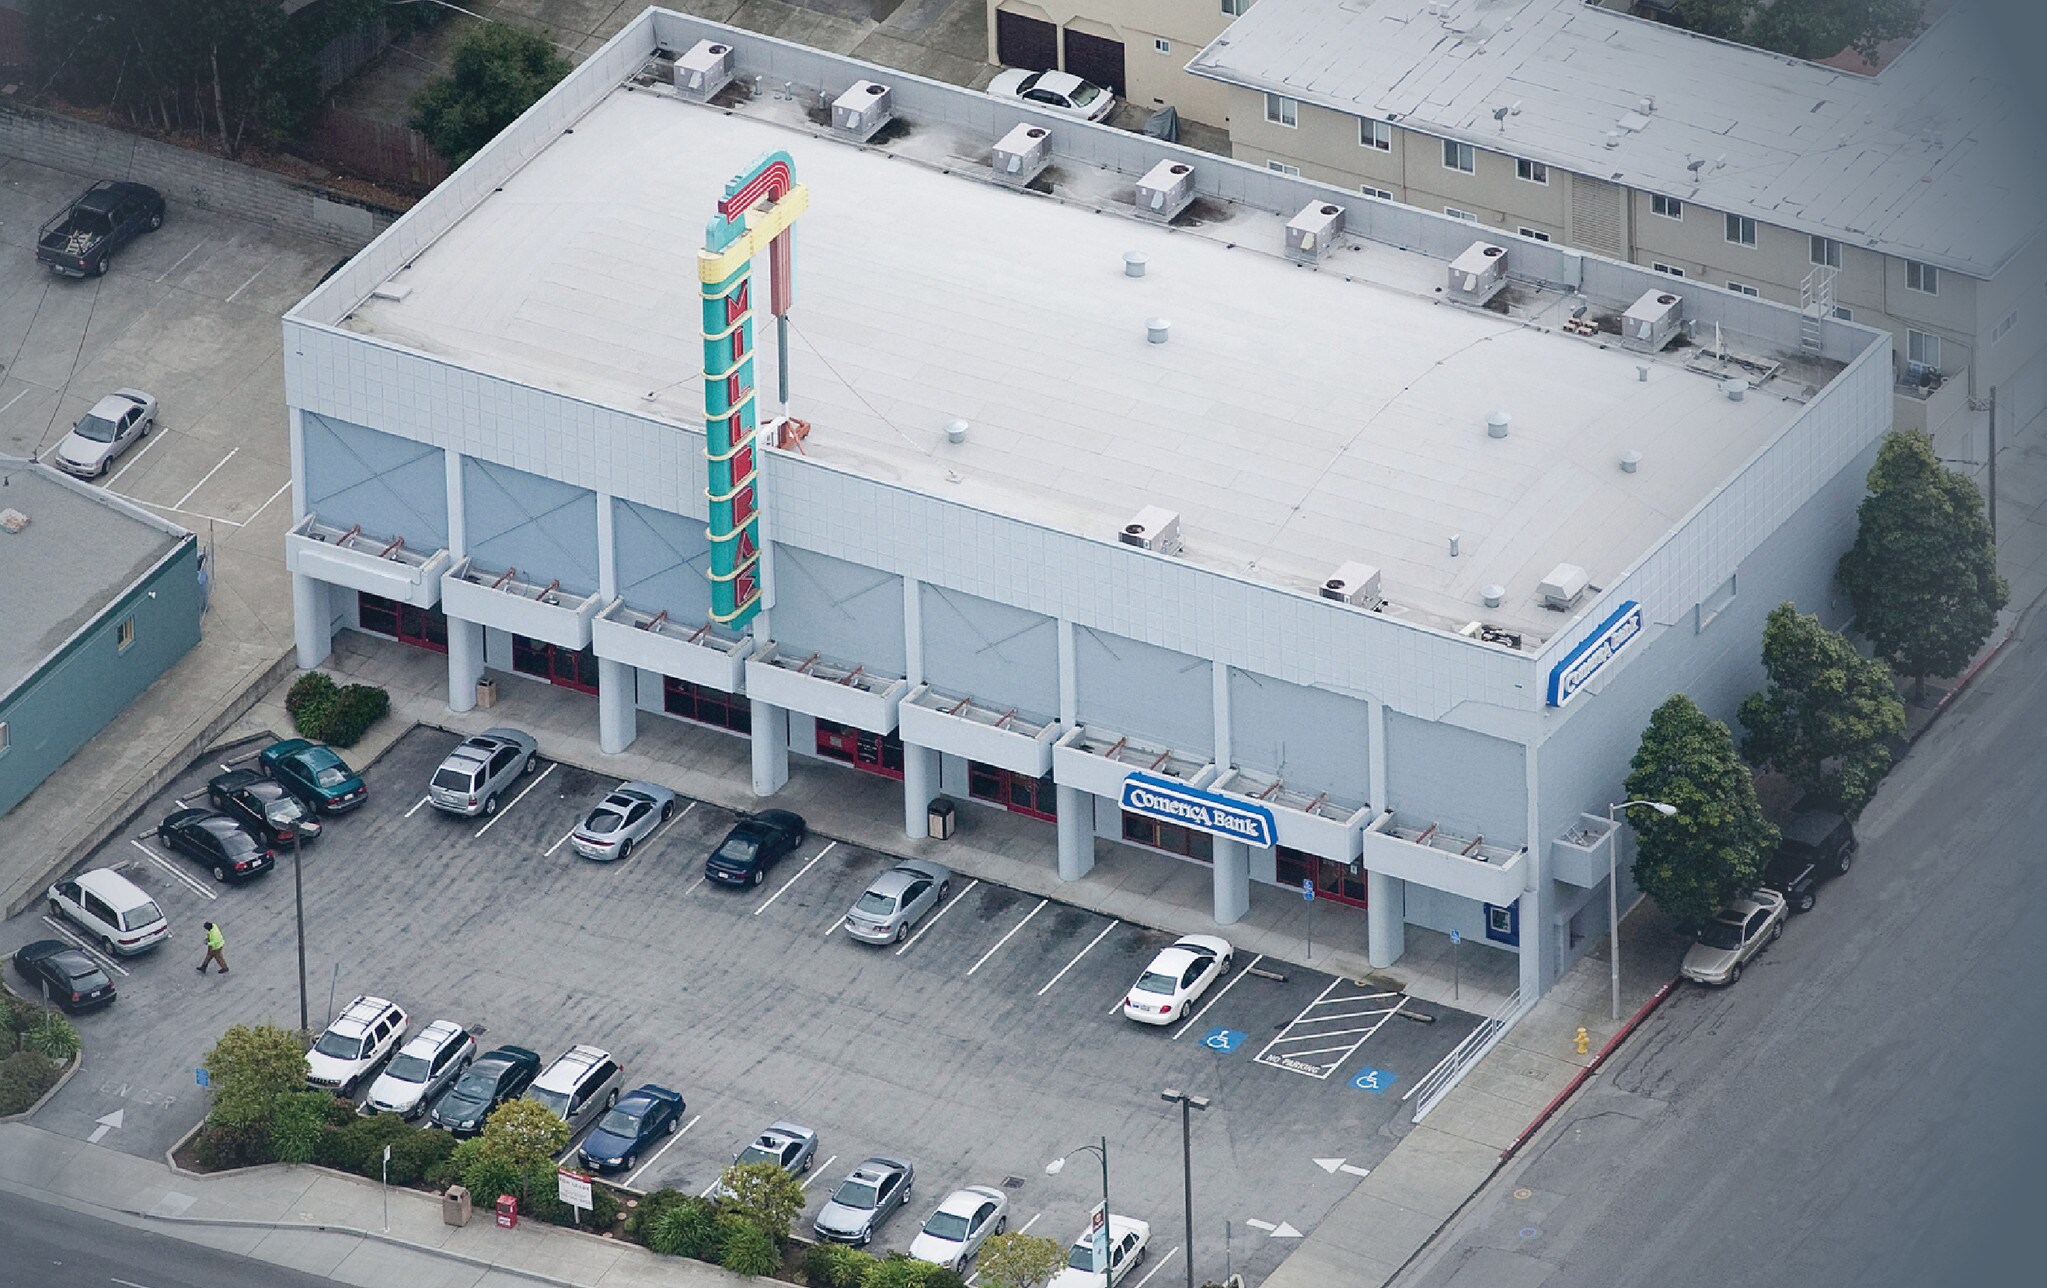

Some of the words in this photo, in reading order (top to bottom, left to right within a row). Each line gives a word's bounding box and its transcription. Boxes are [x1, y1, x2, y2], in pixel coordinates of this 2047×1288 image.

[726, 279, 757, 607] MILLBRAE
[1212, 809, 1260, 837] Bank
[1266, 1054, 1281, 1063] NO
[1282, 1058, 1320, 1073] PARKING
